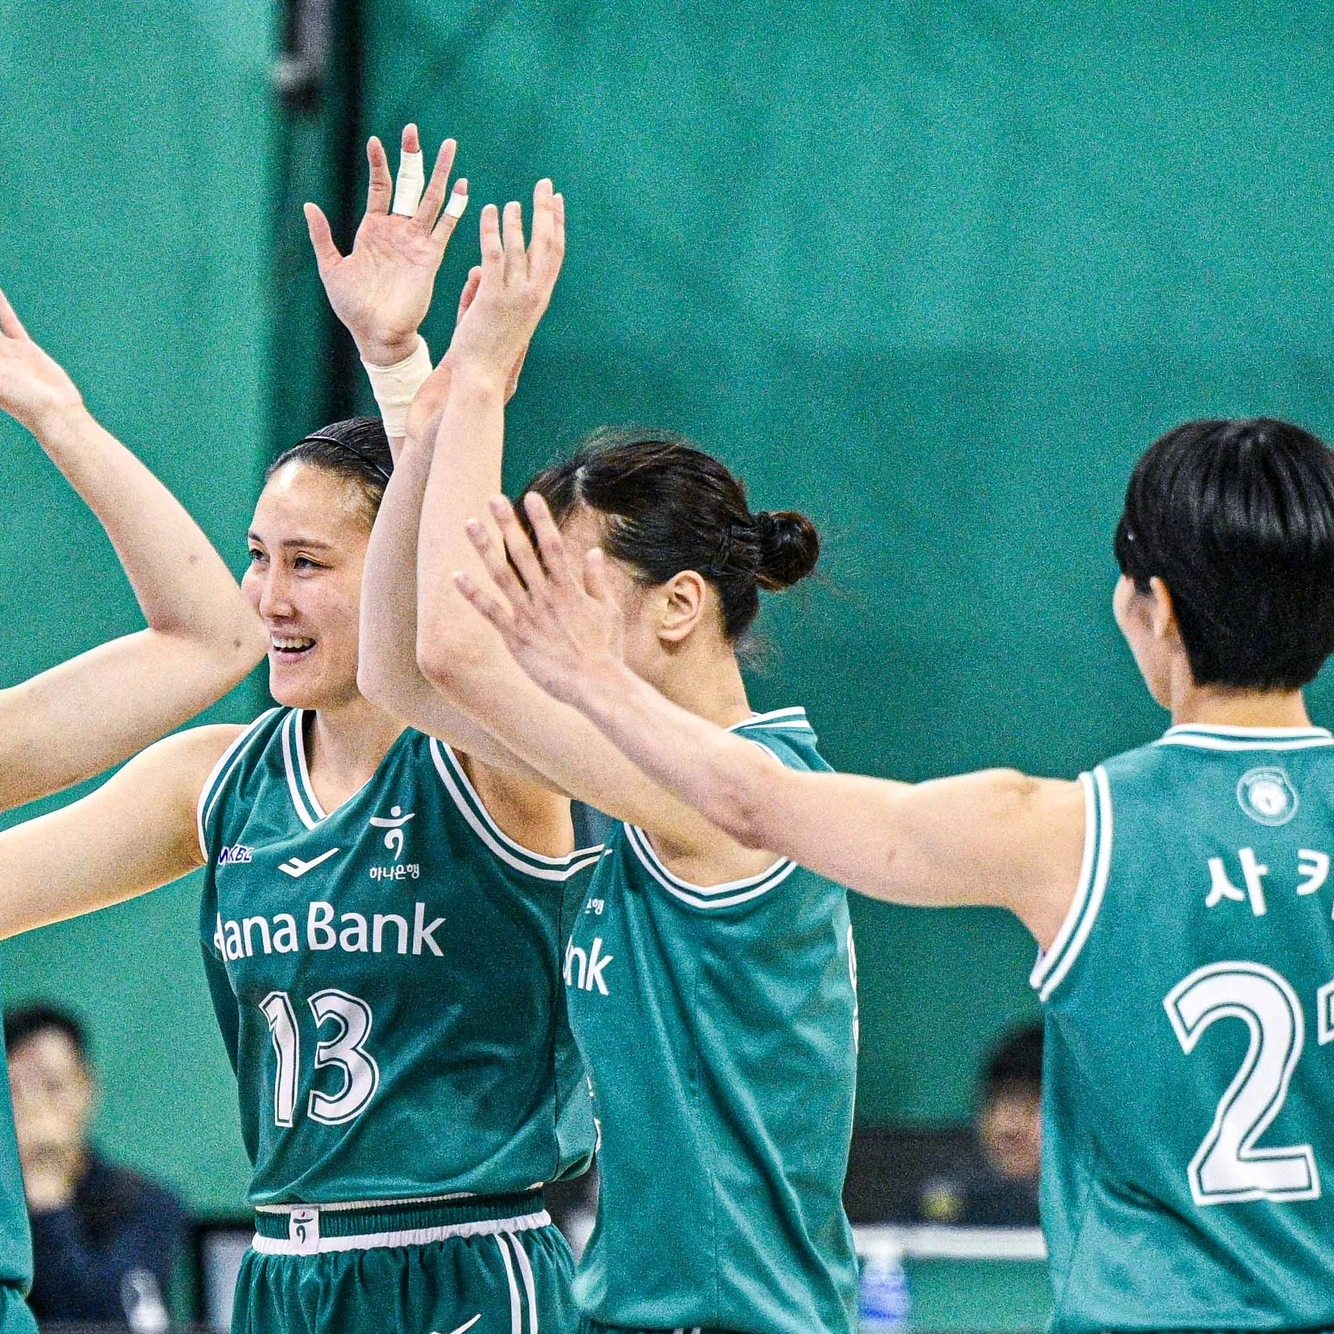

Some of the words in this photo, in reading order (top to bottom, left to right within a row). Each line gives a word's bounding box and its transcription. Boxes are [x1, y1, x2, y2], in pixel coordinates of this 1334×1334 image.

[369, 863, 420, 881] 하나은행
[307, 901, 446, 957] Bank
[563, 934, 614, 996] nk
[258, 988, 379, 1128] 13
